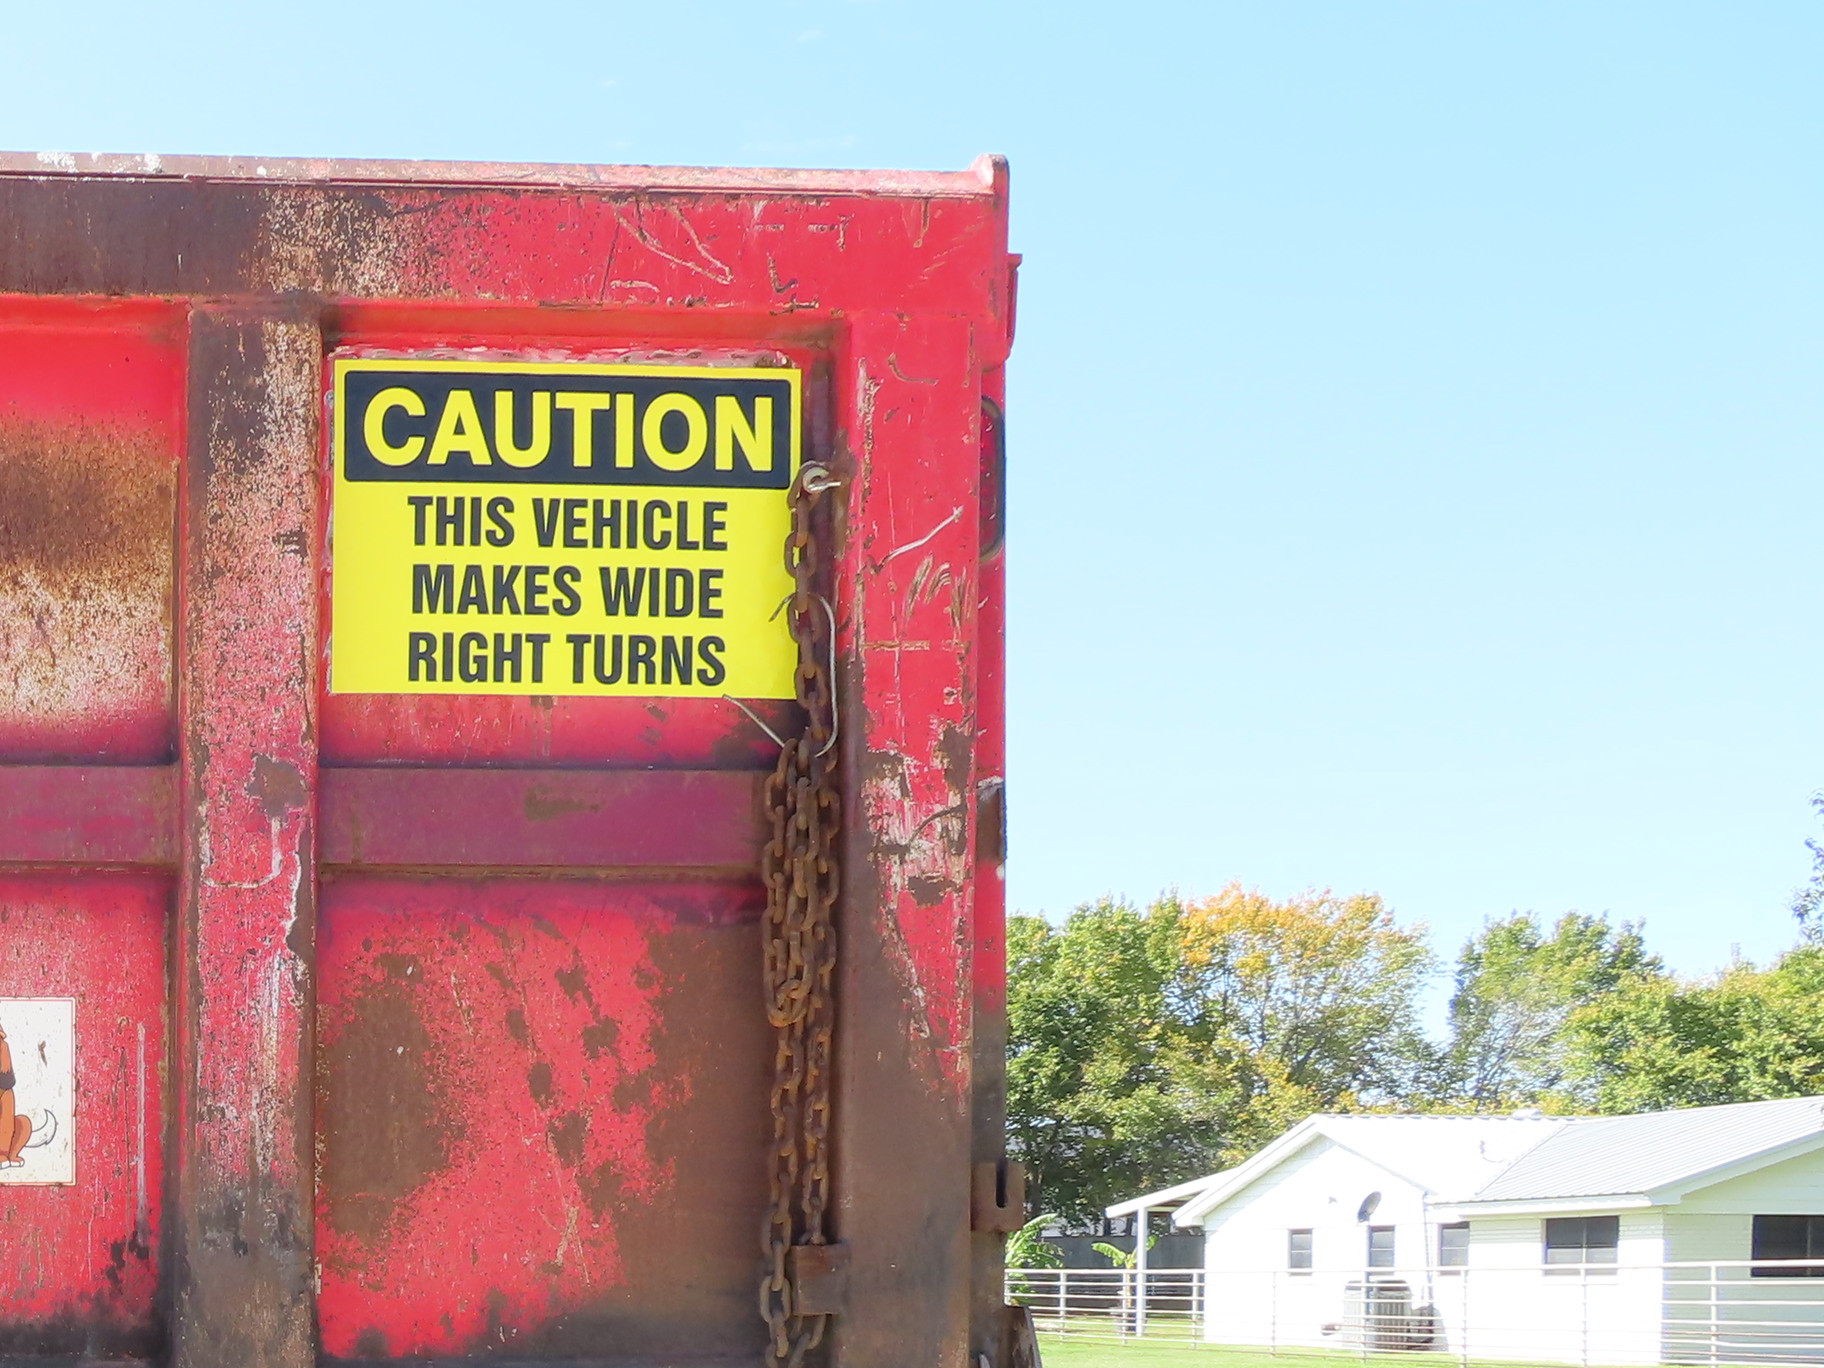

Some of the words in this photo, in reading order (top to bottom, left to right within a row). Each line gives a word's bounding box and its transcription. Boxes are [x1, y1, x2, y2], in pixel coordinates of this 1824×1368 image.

[363, 387, 773, 472] CAUTION
[407, 496, 515, 548] THIS
[532, 498, 728, 551] VEHICLE
[412, 564, 582, 617] MAKES
[599, 567, 724, 619] WIDE
[408, 632, 550, 684] RIGHT
[566, 634, 726, 686] TURNS
